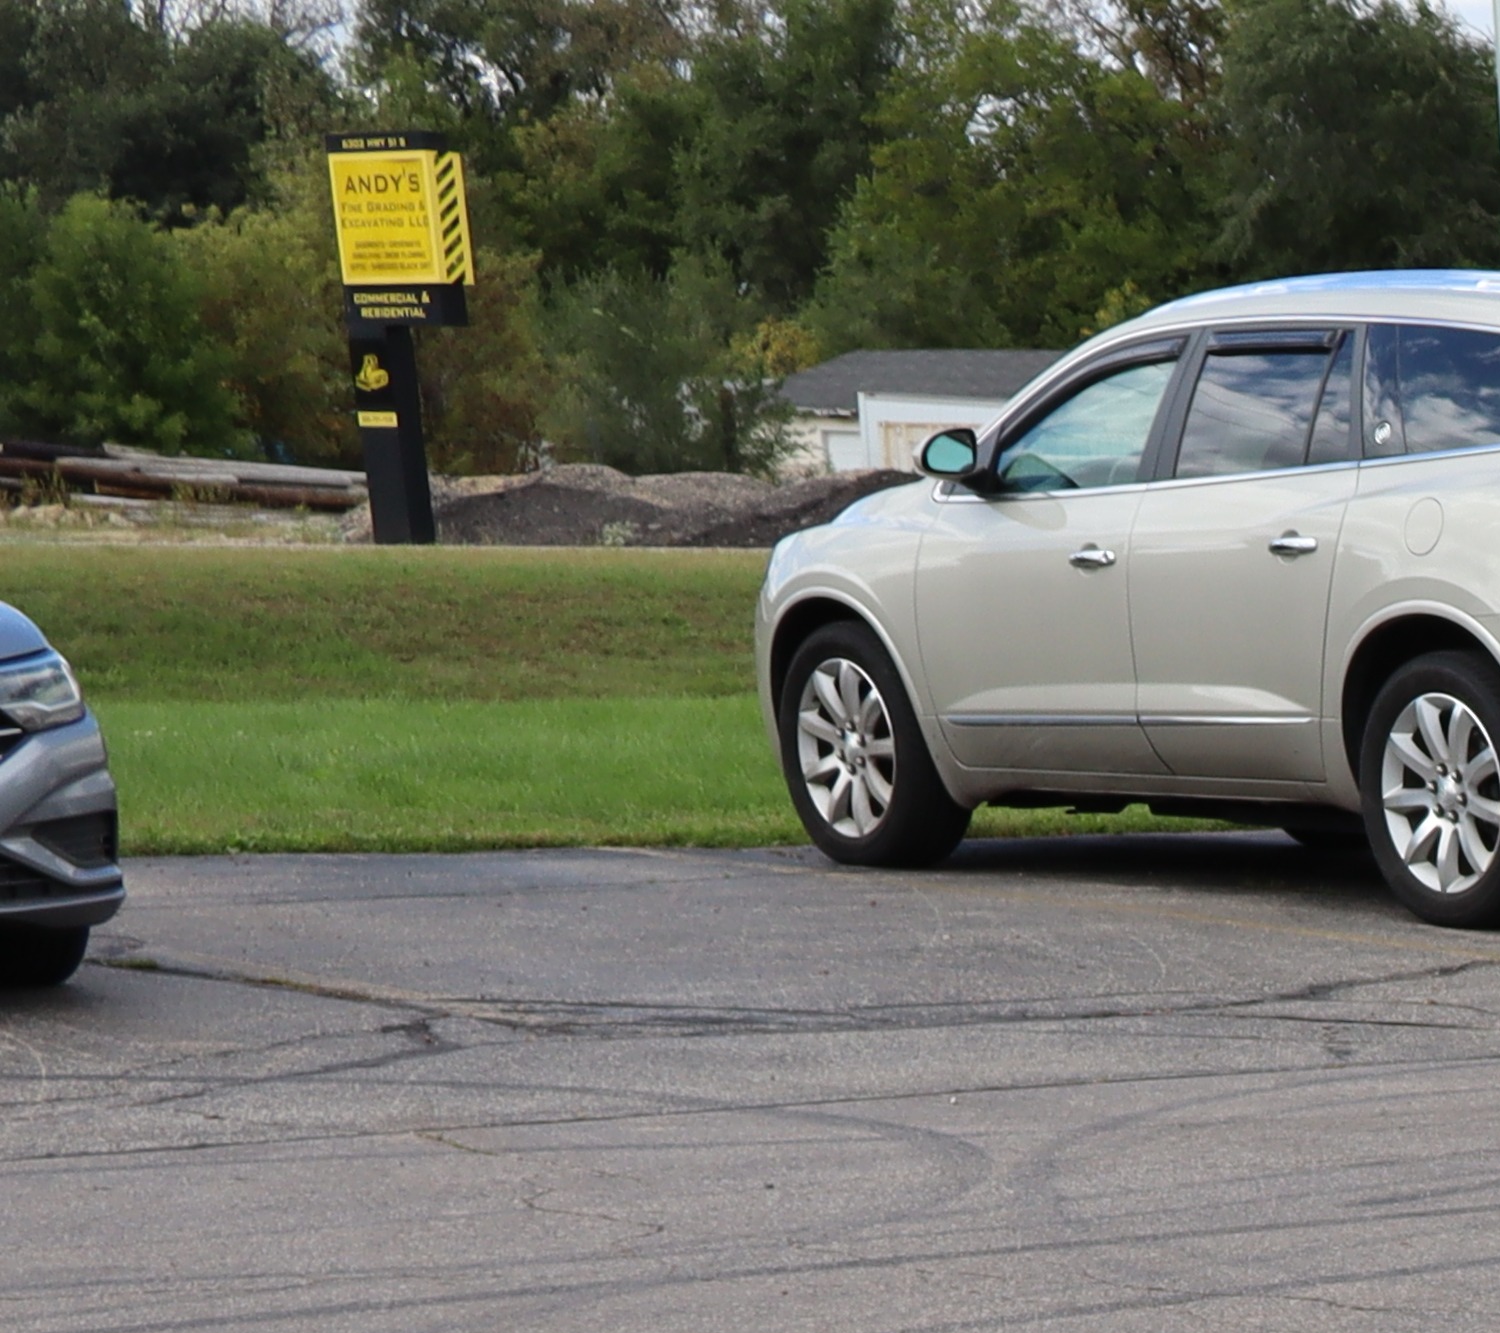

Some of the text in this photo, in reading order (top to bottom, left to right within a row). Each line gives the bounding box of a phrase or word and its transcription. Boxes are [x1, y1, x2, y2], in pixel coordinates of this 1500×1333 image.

[345, 167, 420, 194] ANDY'S
[367, 201, 416, 212] GRADING
[353, 290, 430, 304] COMMERCIAL &
[360, 306, 426, 319] RESIDENTIAL
